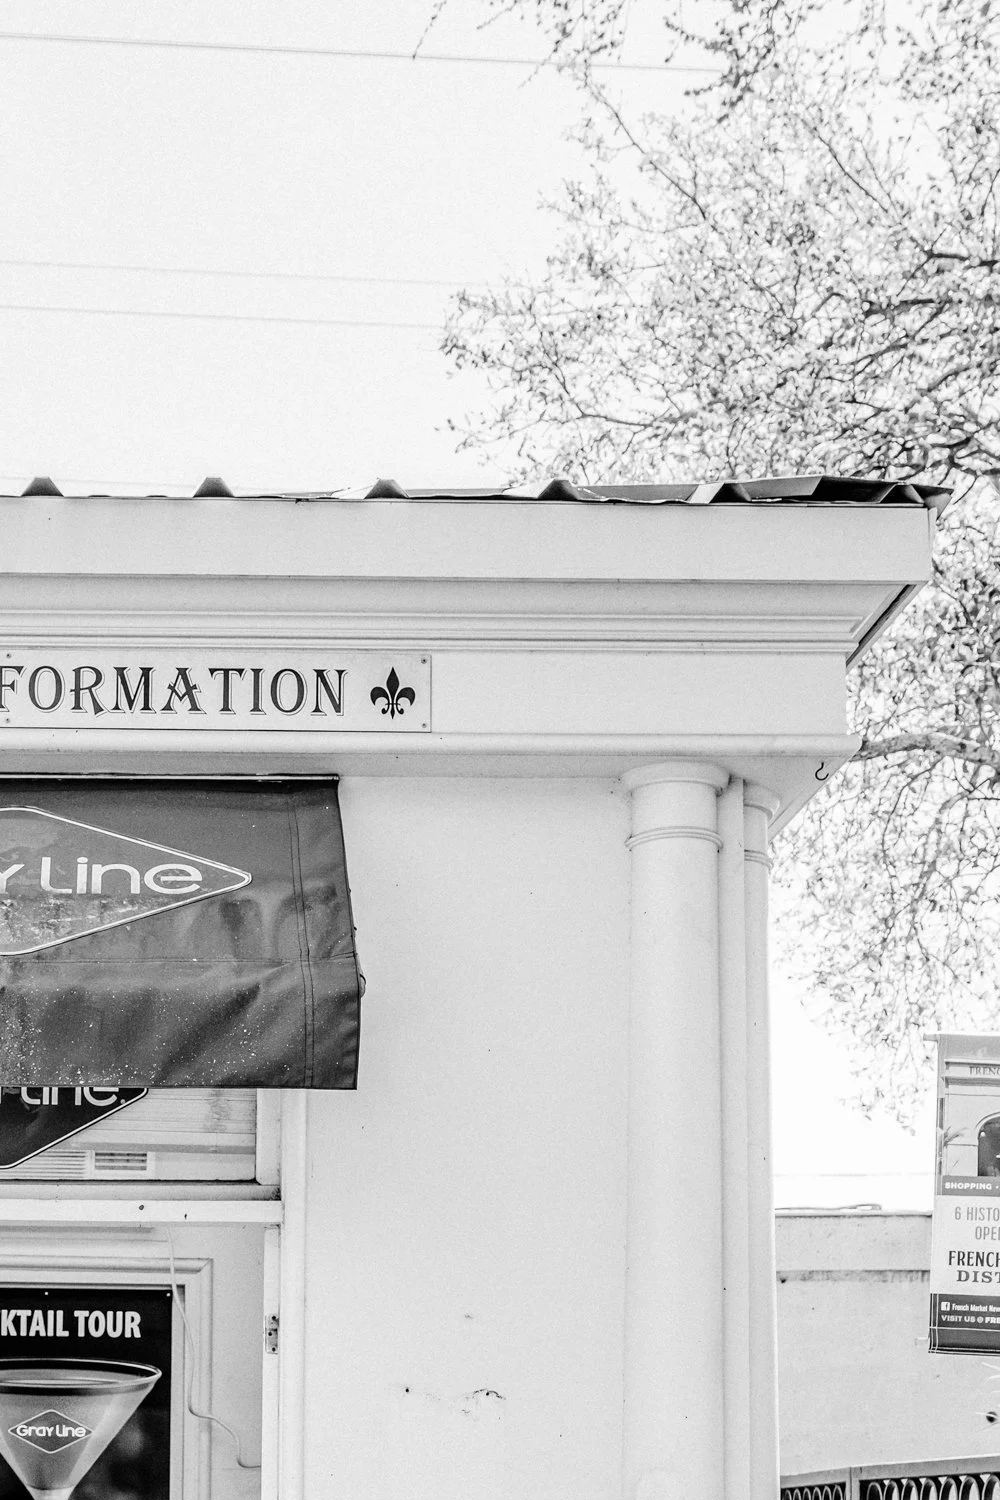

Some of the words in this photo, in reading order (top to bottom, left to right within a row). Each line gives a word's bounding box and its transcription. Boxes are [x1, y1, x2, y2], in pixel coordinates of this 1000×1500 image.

[41, 856, 204, 895] Line
[944, 1182, 992, 1190] SHOPPING
[954, 1206, 961, 1221] 6
[952, 1303, 969, 1311] French
[970, 1304, 988, 1312] Market
[74, 1310, 142, 1339] TOUR
[16, 1424, 54, 1438] Gray
[56, 1425, 87, 1438] Line
